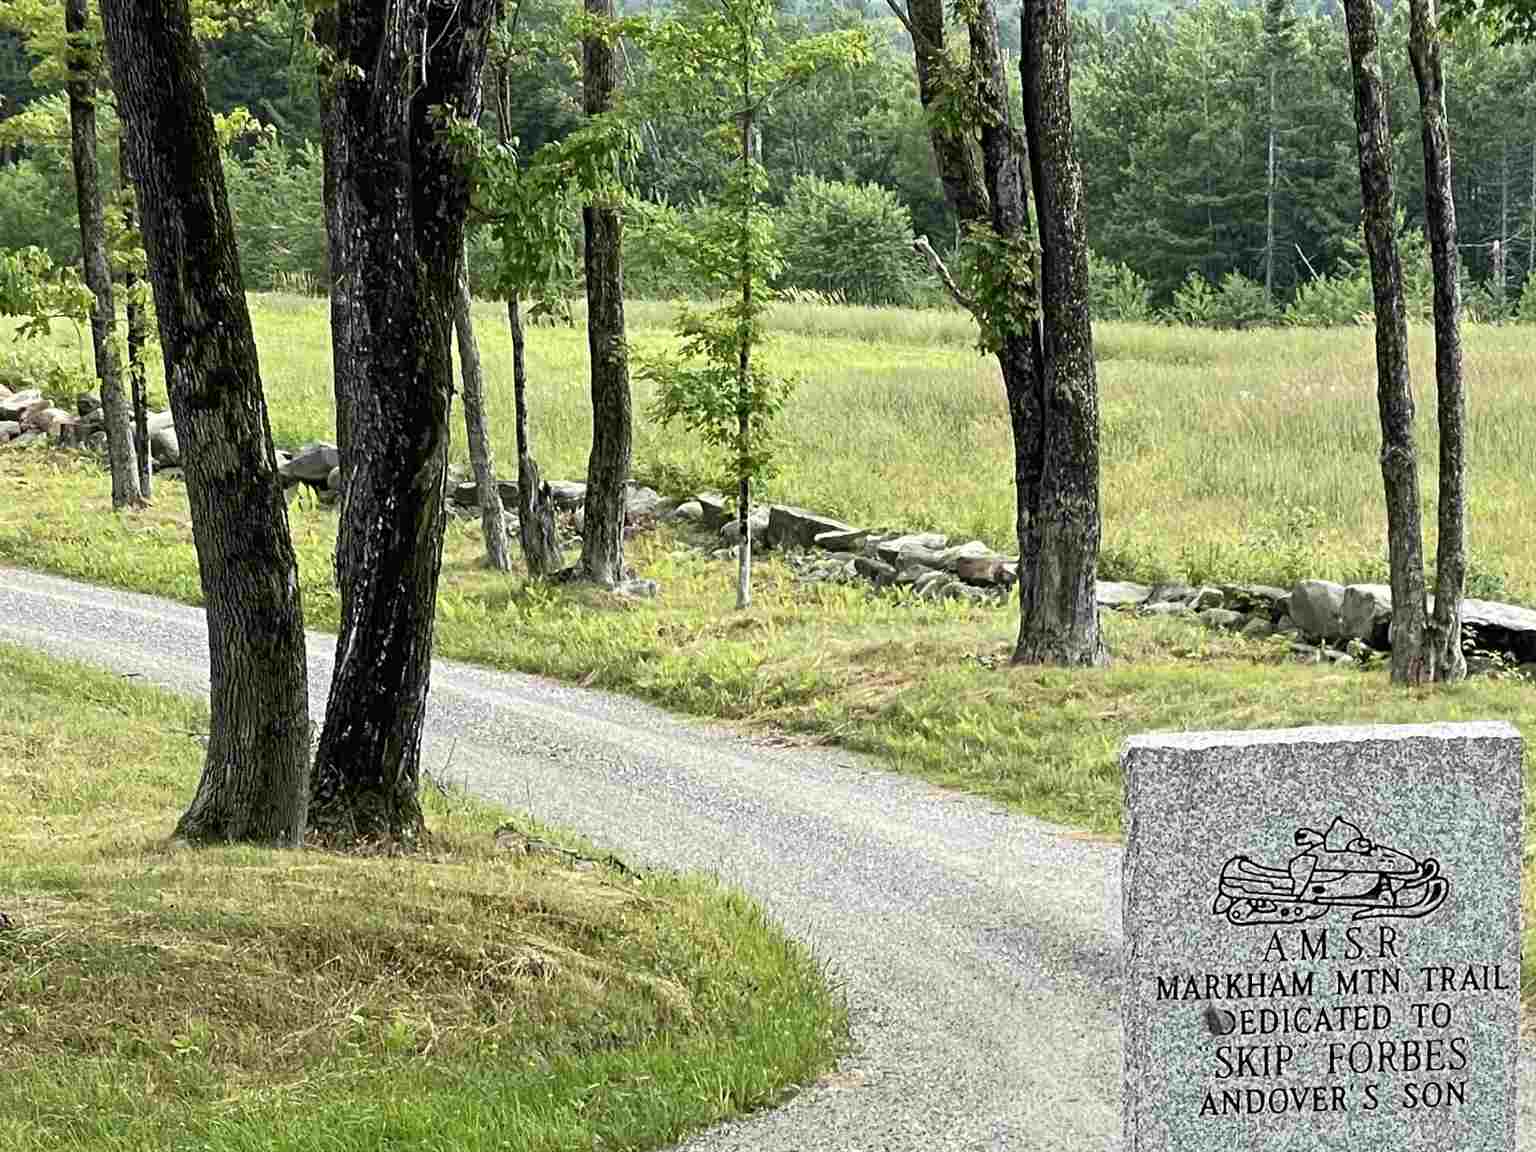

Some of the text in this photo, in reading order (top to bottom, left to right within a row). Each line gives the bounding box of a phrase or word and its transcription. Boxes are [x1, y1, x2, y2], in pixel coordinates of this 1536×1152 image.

[1156, 971, 1314, 1001] MARKHAM
[1420, 965, 1509, 992] TRAIL
[1215, 1002, 1452, 1036] DEDICATED TO
[1327, 1037, 1467, 1074] FORBES
[1402, 1081, 1465, 1109] SON
